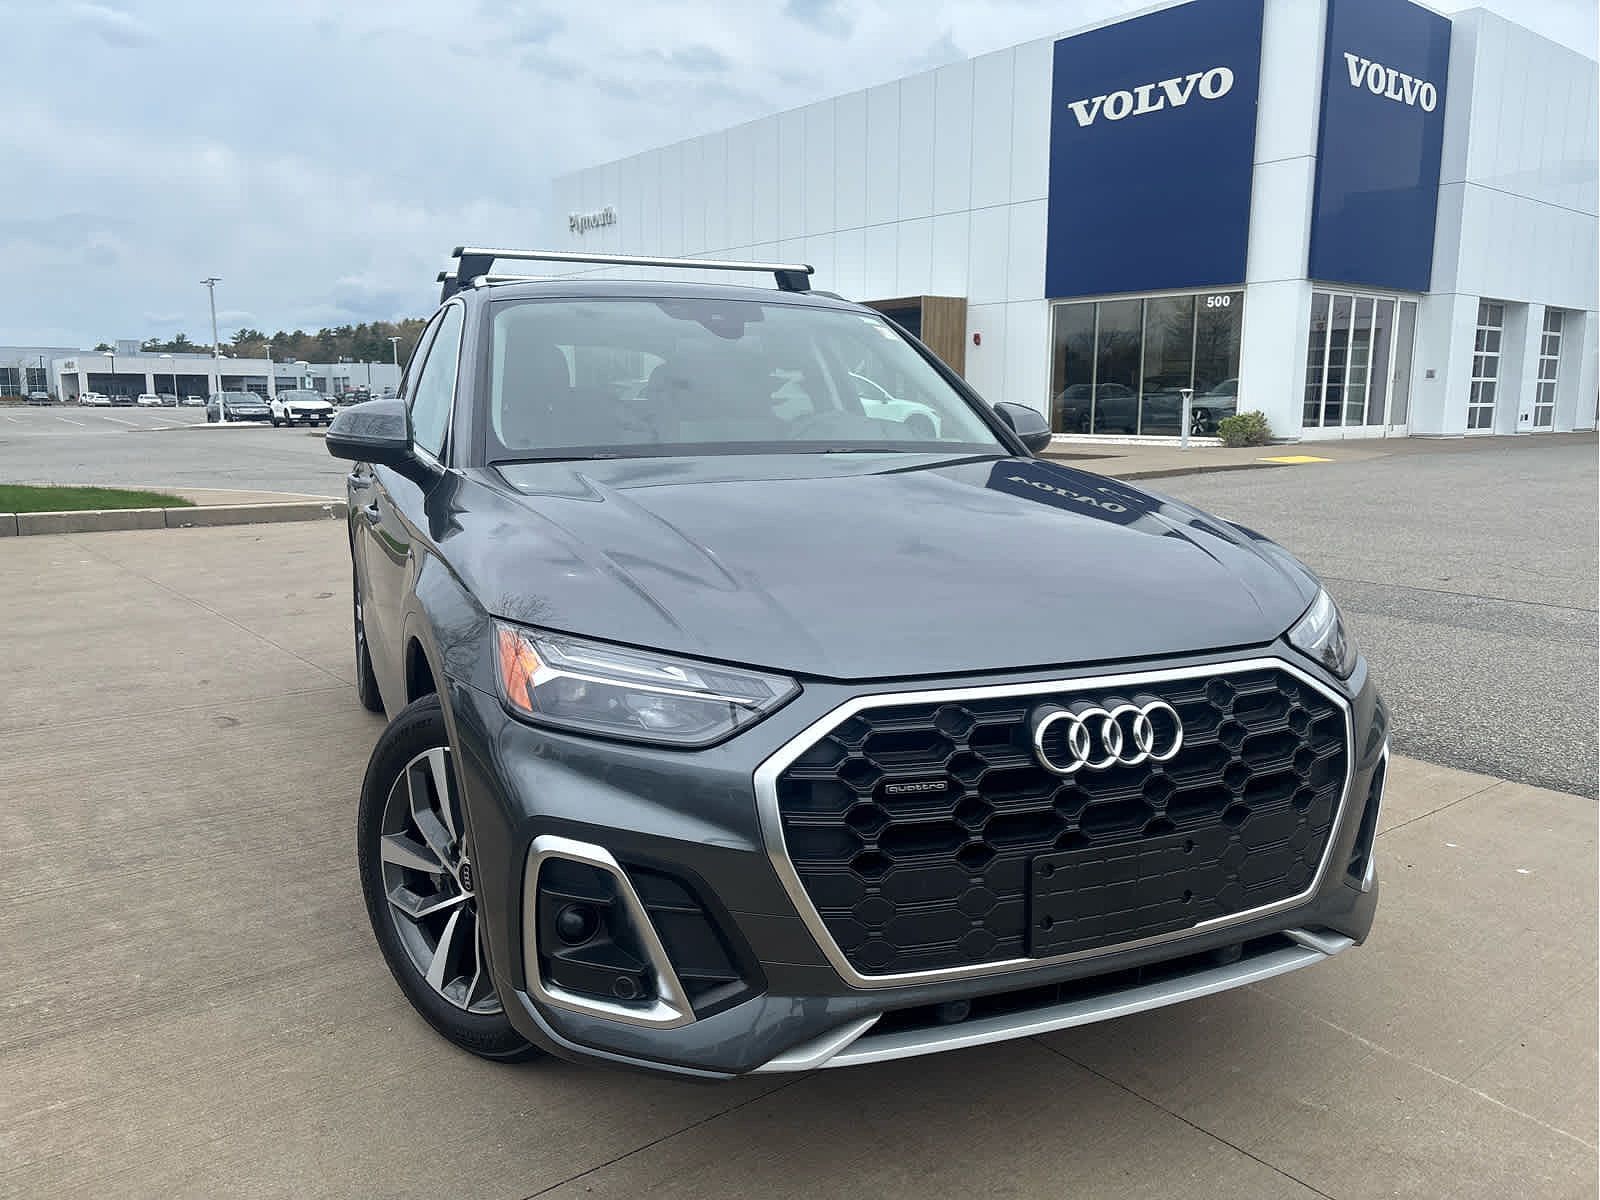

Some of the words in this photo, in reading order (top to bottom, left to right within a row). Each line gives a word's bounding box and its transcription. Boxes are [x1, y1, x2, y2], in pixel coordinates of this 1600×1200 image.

[1343, 51, 1437, 112] VOLVO
[1068, 67, 1234, 127] VOLVO
[568, 206, 617, 234] Plymouth
[1207, 295, 1231, 308] 500
[887, 782, 946, 793] quattro
